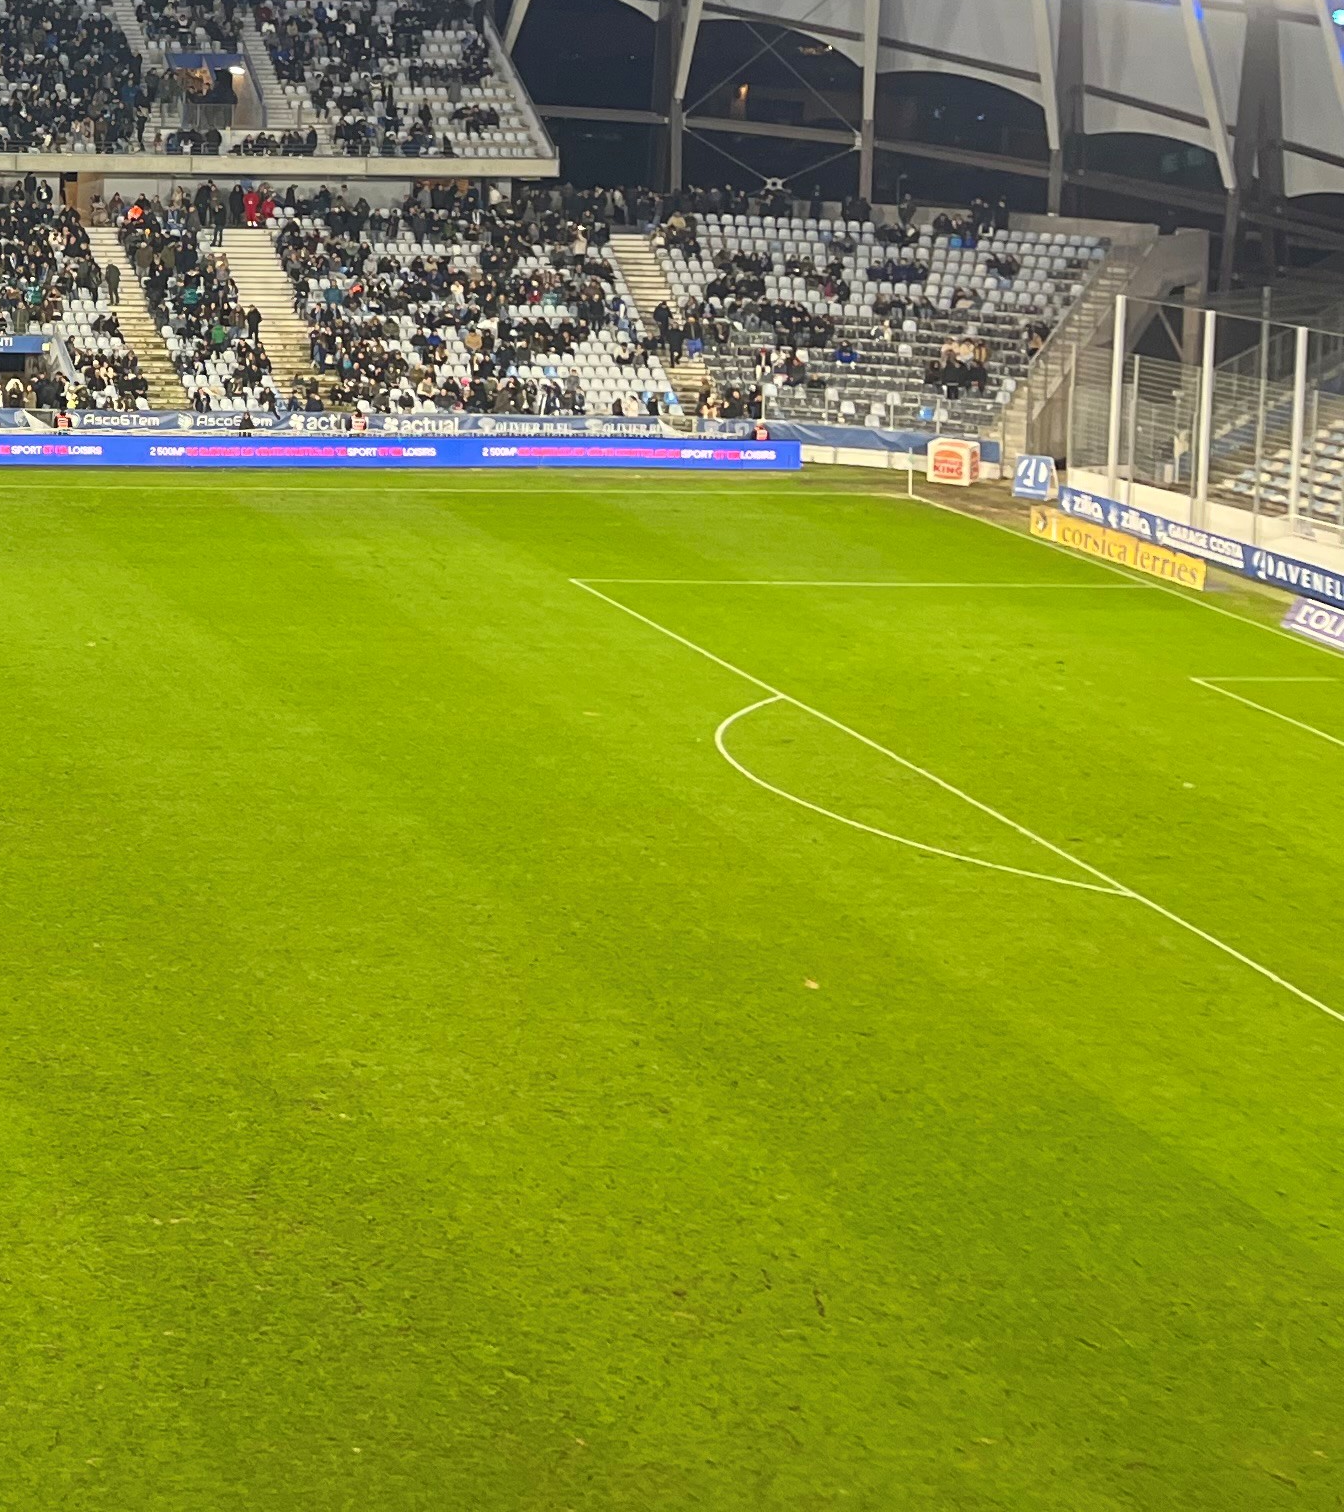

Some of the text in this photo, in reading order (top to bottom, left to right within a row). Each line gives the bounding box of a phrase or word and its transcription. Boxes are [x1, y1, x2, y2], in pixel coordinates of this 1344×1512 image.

[400, 416, 460, 433] actual
[10, 445, 42, 455] SPORT
[68, 445, 102, 456] LOISIRS
[346, 447, 378, 457] SPORT
[402, 447, 437, 457] LOISIRS
[680, 449, 713, 459] SPORT
[739, 450, 777, 460] LOISIRS
[933, 465, 963, 475] KING
[1061, 526, 1128, 561] corsica
[1133, 539, 1198, 585] ferries
